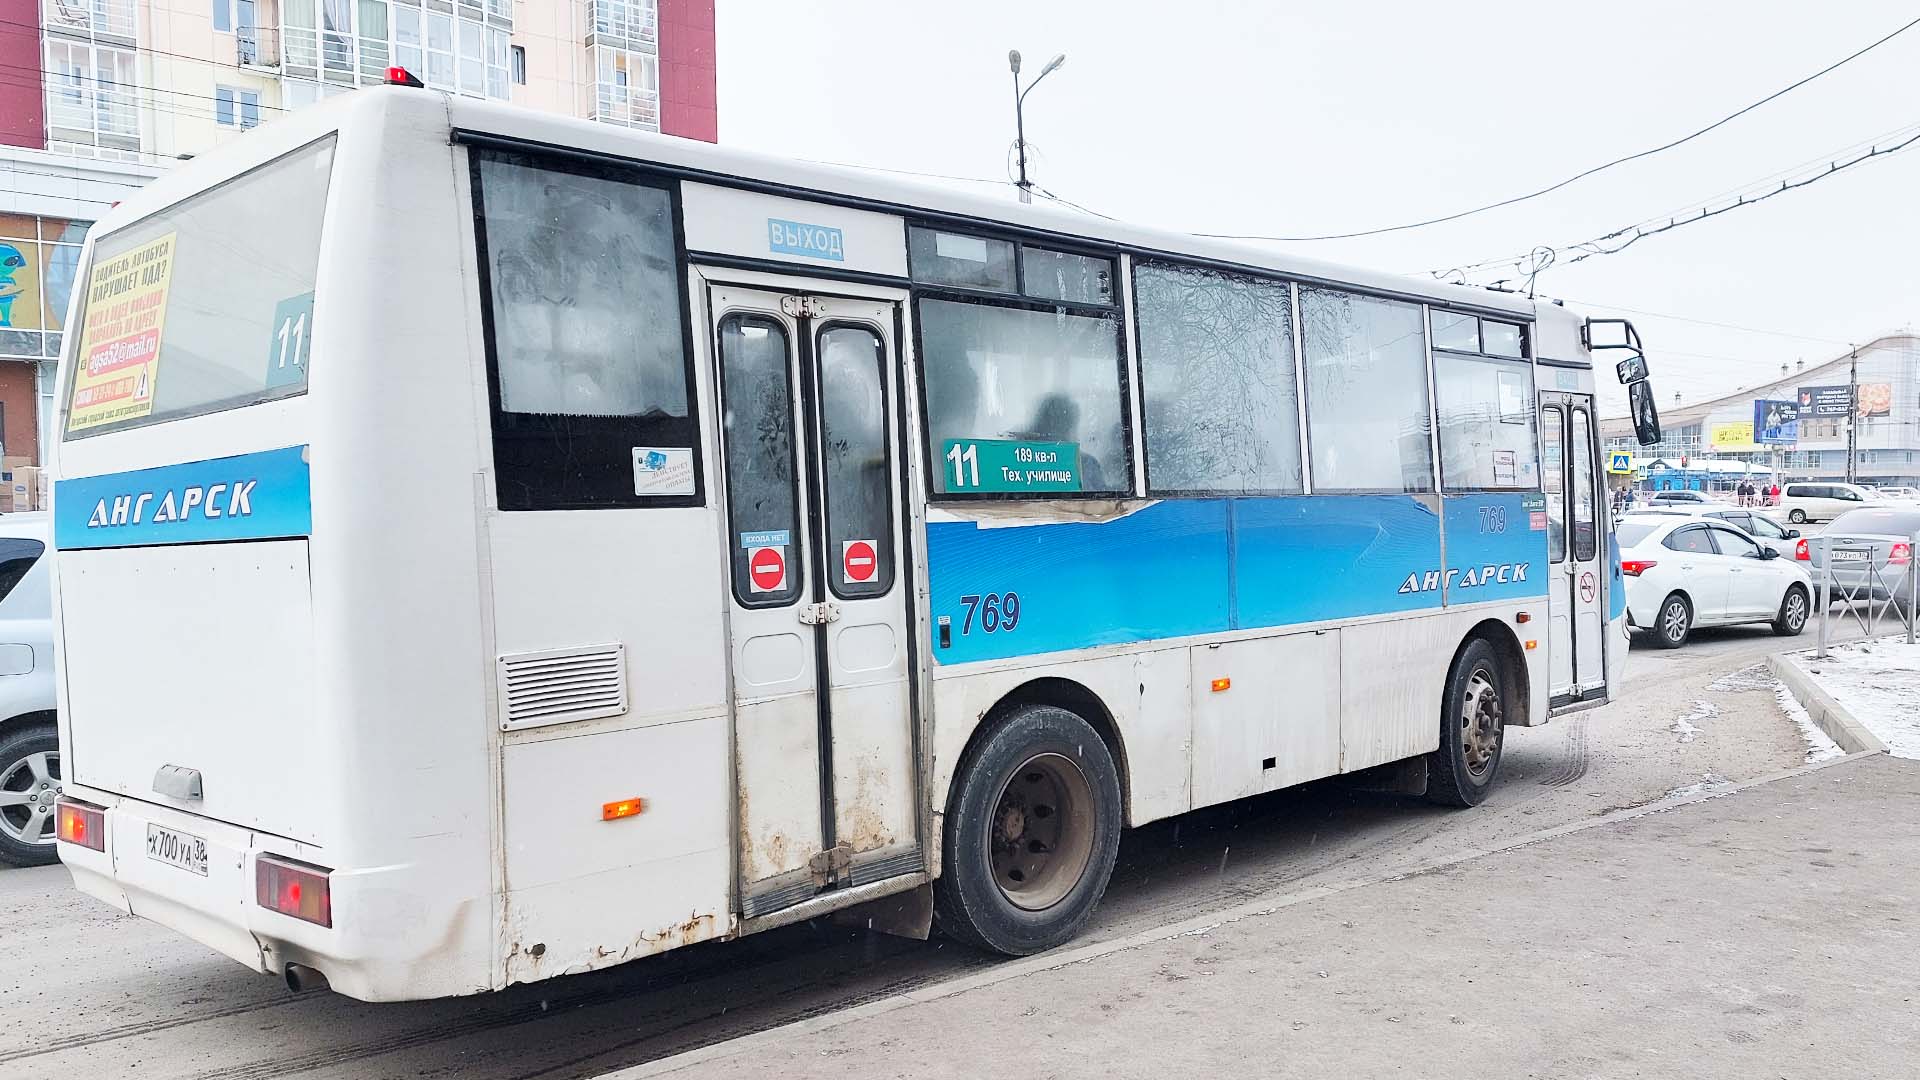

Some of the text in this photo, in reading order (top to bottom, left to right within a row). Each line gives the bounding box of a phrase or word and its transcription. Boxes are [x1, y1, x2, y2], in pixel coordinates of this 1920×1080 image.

[771, 223, 841, 257] ВЫХОД
[95, 241, 169, 282] ВОДИТЕЛЬ АВТОБУСА
[92, 270, 139, 304] НАРУШАЕТ
[278, 312, 305, 369] 11
[949, 443, 980, 487] 11
[1014, 448, 1057, 463] 189 кв-л
[1001, 467, 1072, 485] Тех. училище
[87, 480, 258, 529] АНГАРСК
[1479, 506, 1507, 534] 769
[745, 534, 785, 543] ВХОДА НЕТ
[1398, 562, 1529, 594] АНГАРСК
[960, 591, 1020, 636] 769
